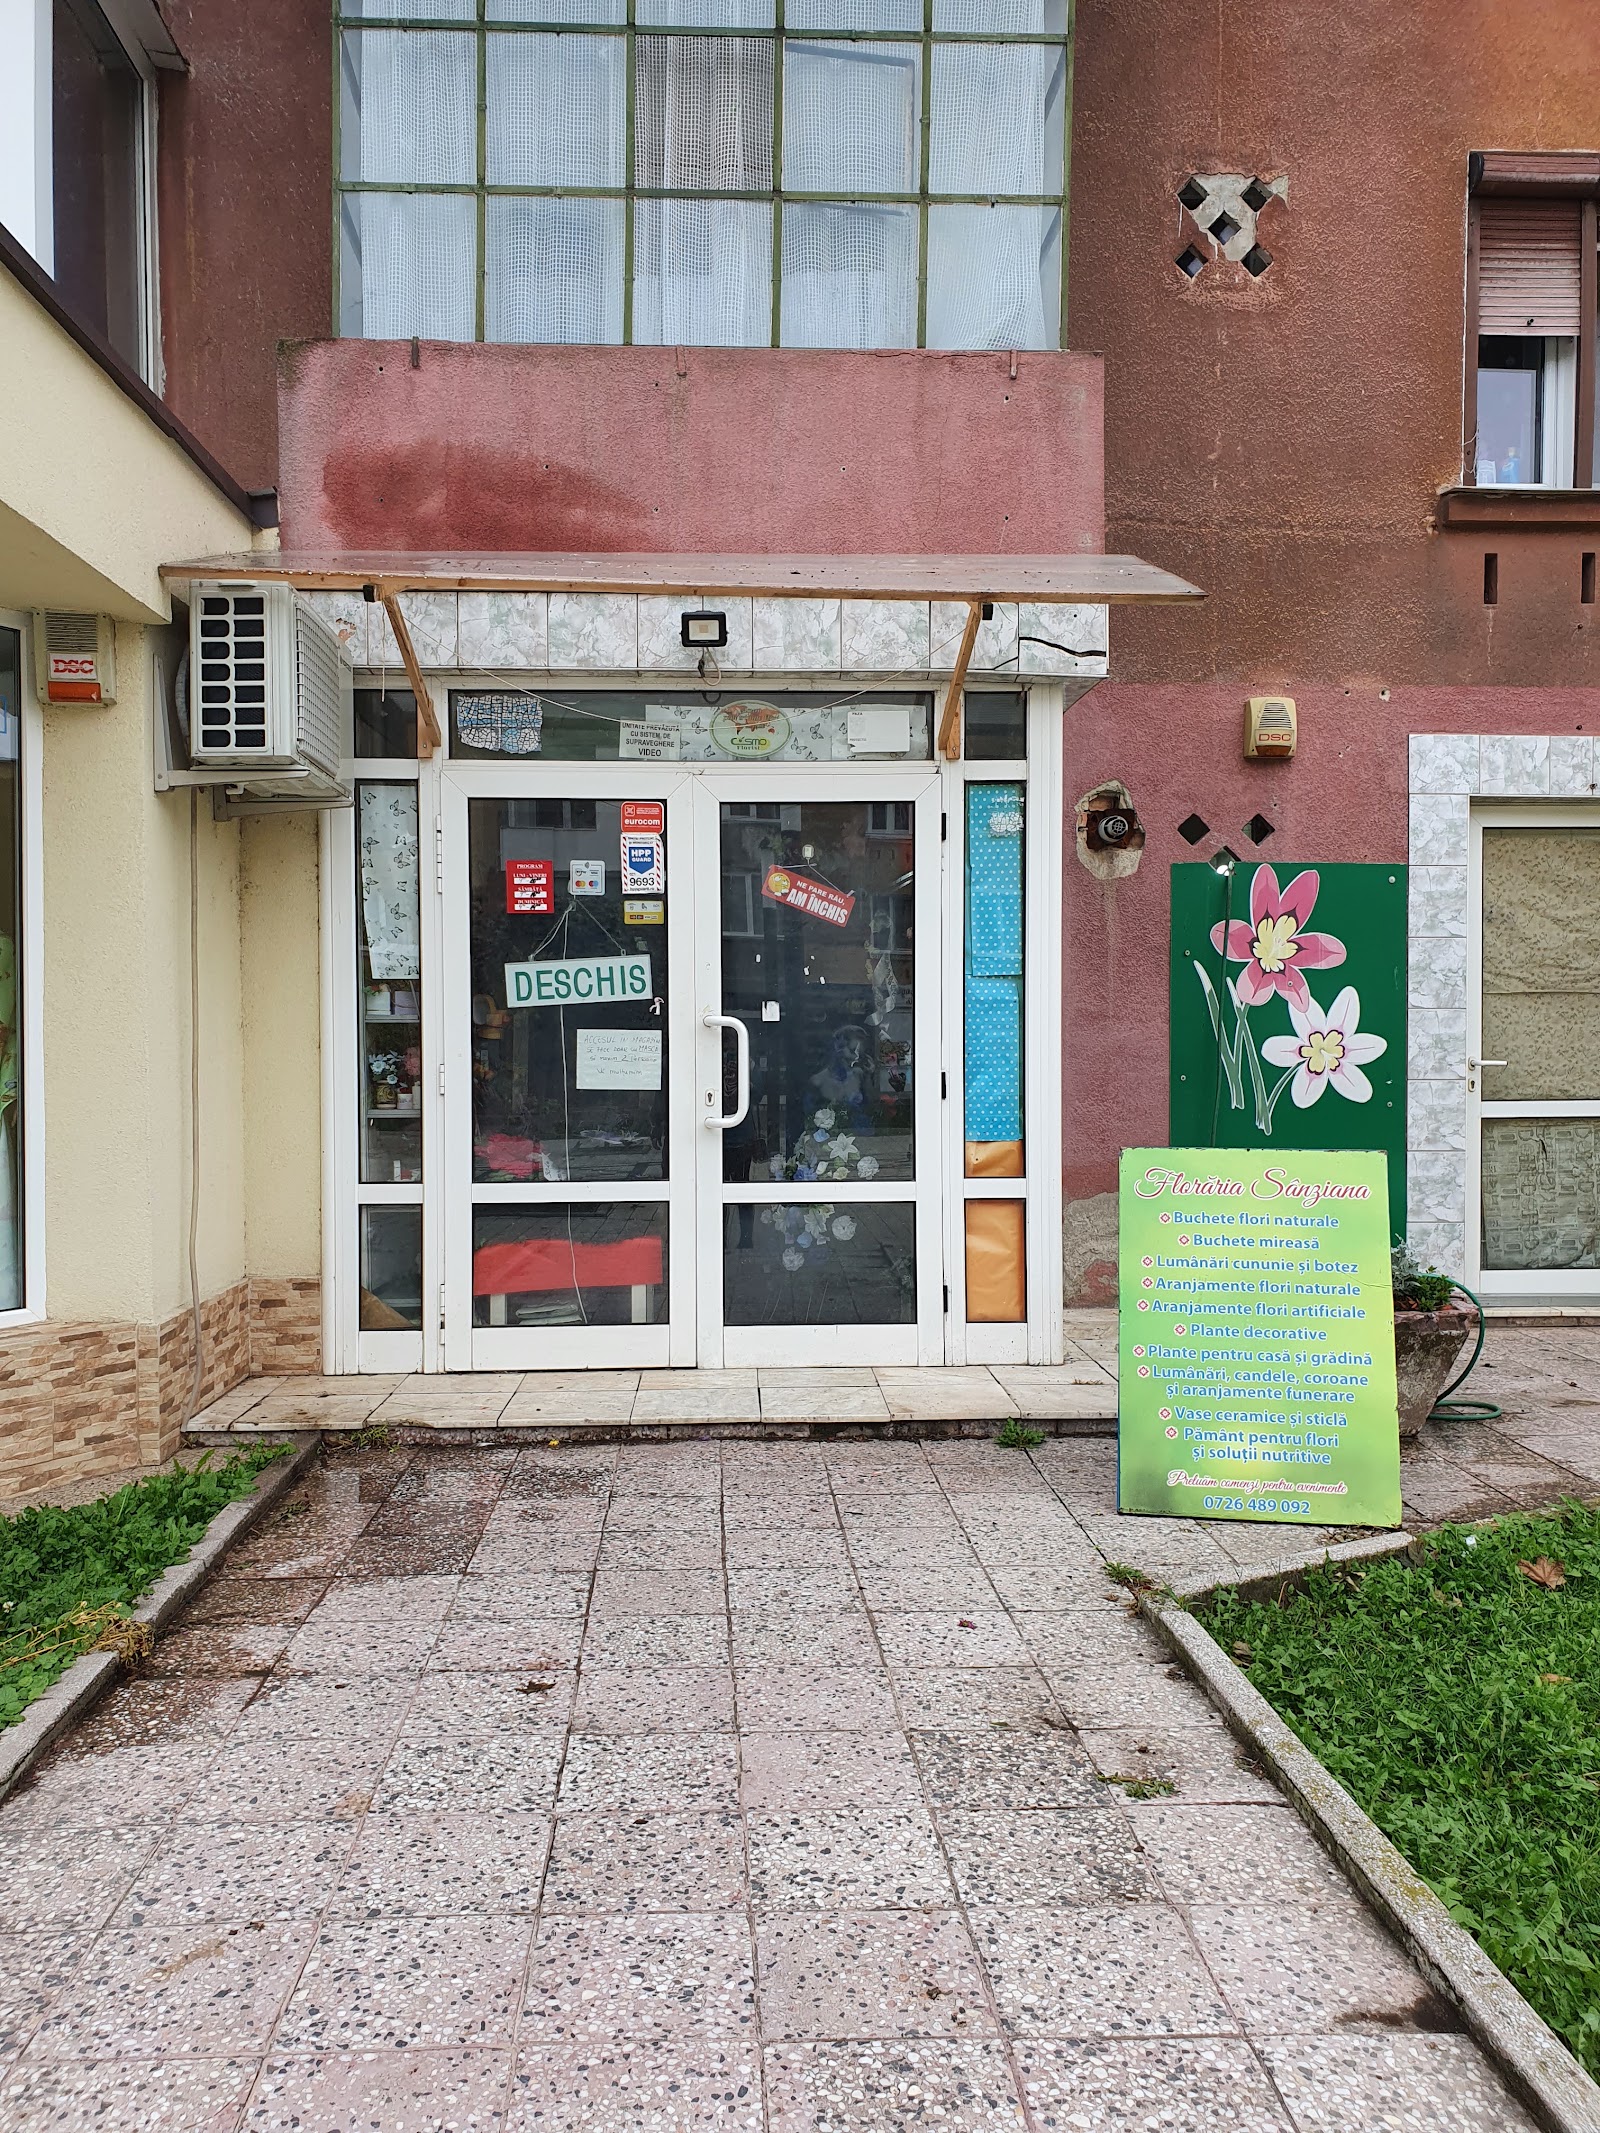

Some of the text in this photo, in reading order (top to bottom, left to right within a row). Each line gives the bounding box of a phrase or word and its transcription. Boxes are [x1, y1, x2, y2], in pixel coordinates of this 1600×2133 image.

[53, 659, 94, 673] DSC
[622, 722, 645, 730] UNITATE
[640, 731, 660, 739] SISTEM
[626, 738, 675, 748] SUPRAVEGHERE
[638, 748, 662, 757] VIDEO
[630, 878, 654, 886] 9693
[796, 880, 808, 889] NE
[808, 885, 827, 897] PARE
[786, 888, 848, 923] AM ÎNCHIS
[515, 964, 647, 1001] DESCHIS
[1134, 1167, 1371, 1208] Florăria Sânziana
[1173, 1211, 1339, 1228] Buchete flori naturale
[1193, 1234, 1320, 1249] Buchete mireasă
[1156, 1255, 1358, 1274] Lumânări cununie și botez
[1155, 1277, 1361, 1296] Aranjamente flori naturale
[1152, 1300, 1366, 1318] Aranjamente flori artificiale
[1190, 1324, 1327, 1340] Plante decorative
[1147, 1345, 1372, 1367] Plante pentru casă și grădină
[1153, 1366, 1369, 1386] Lumânări, candele, coroane
[1166, 1383, 1355, 1402] și aranjamente funerare
[1174, 1407, 1348, 1427] Vase ceramice și sticlă
[1183, 1427, 1339, 1447] Pământ pentru flori
[1192, 1446, 1331, 1464] și soluții nutritive
[1220, 1479, 1260, 1493] comenzi
[1260, 1480, 1294, 1493] pentru
[1297, 1483, 1348, 1494] evenimente
[1203, 1495, 1311, 1514] 0726 489 092
